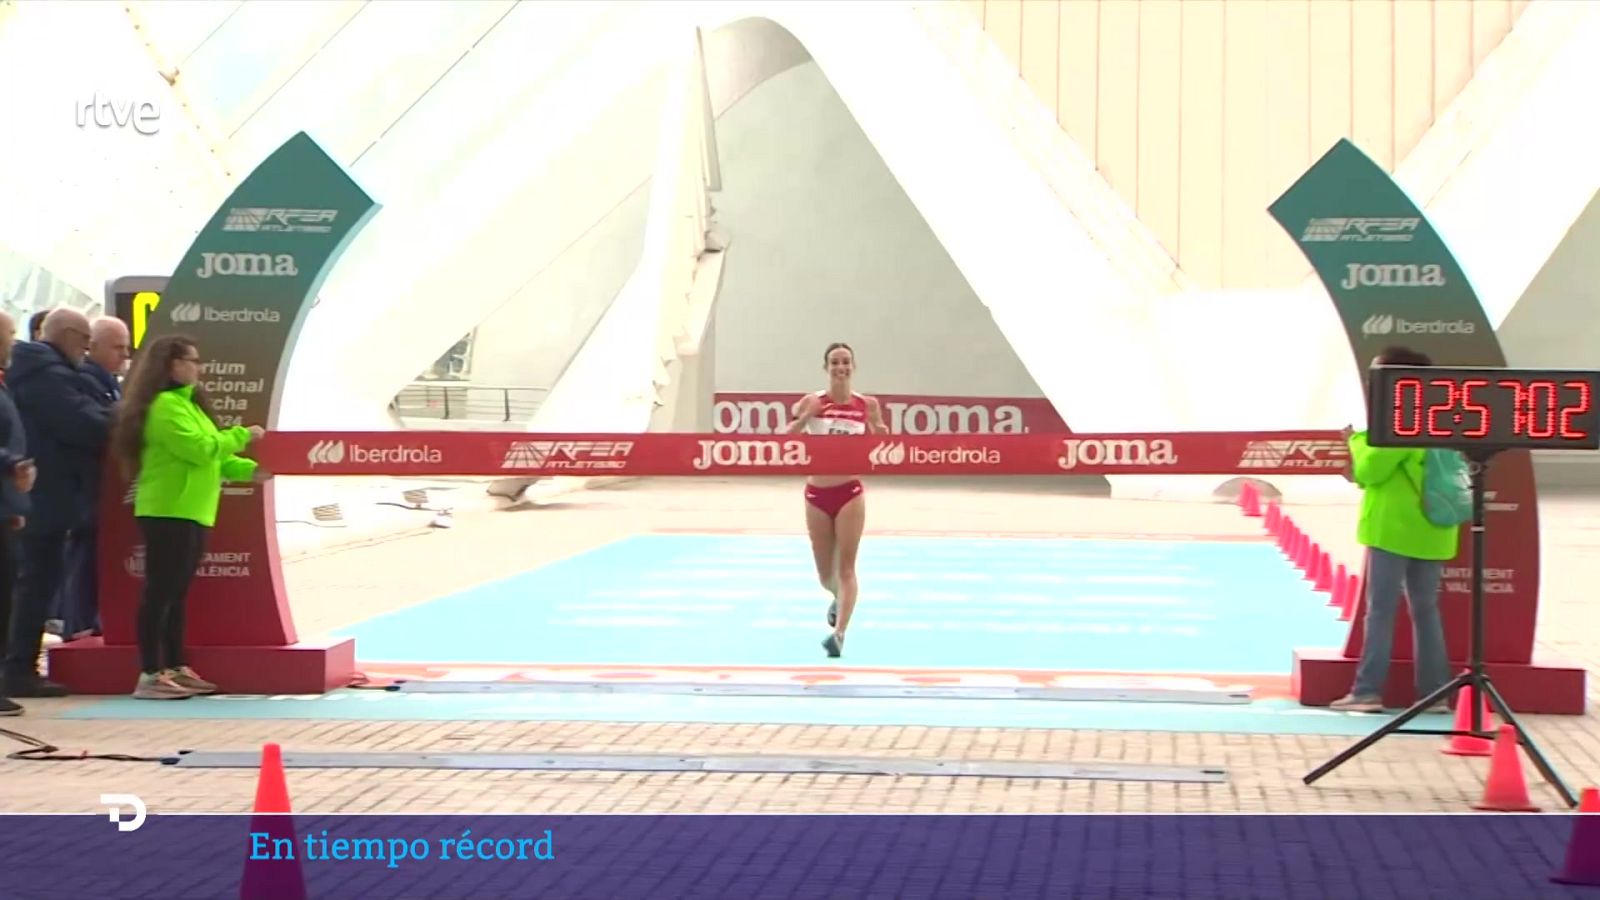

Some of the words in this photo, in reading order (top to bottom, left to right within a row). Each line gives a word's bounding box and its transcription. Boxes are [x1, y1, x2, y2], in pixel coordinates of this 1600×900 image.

[203, 307, 280, 323] Iberdrola
[1396, 318, 1476, 336] Iberdrola
[349, 443, 443, 464] Iberdrola
[550, 440, 635, 460] RFEA
[909, 445, 1001, 464] Iberdrola
[1287, 440, 1348, 460] RFE
